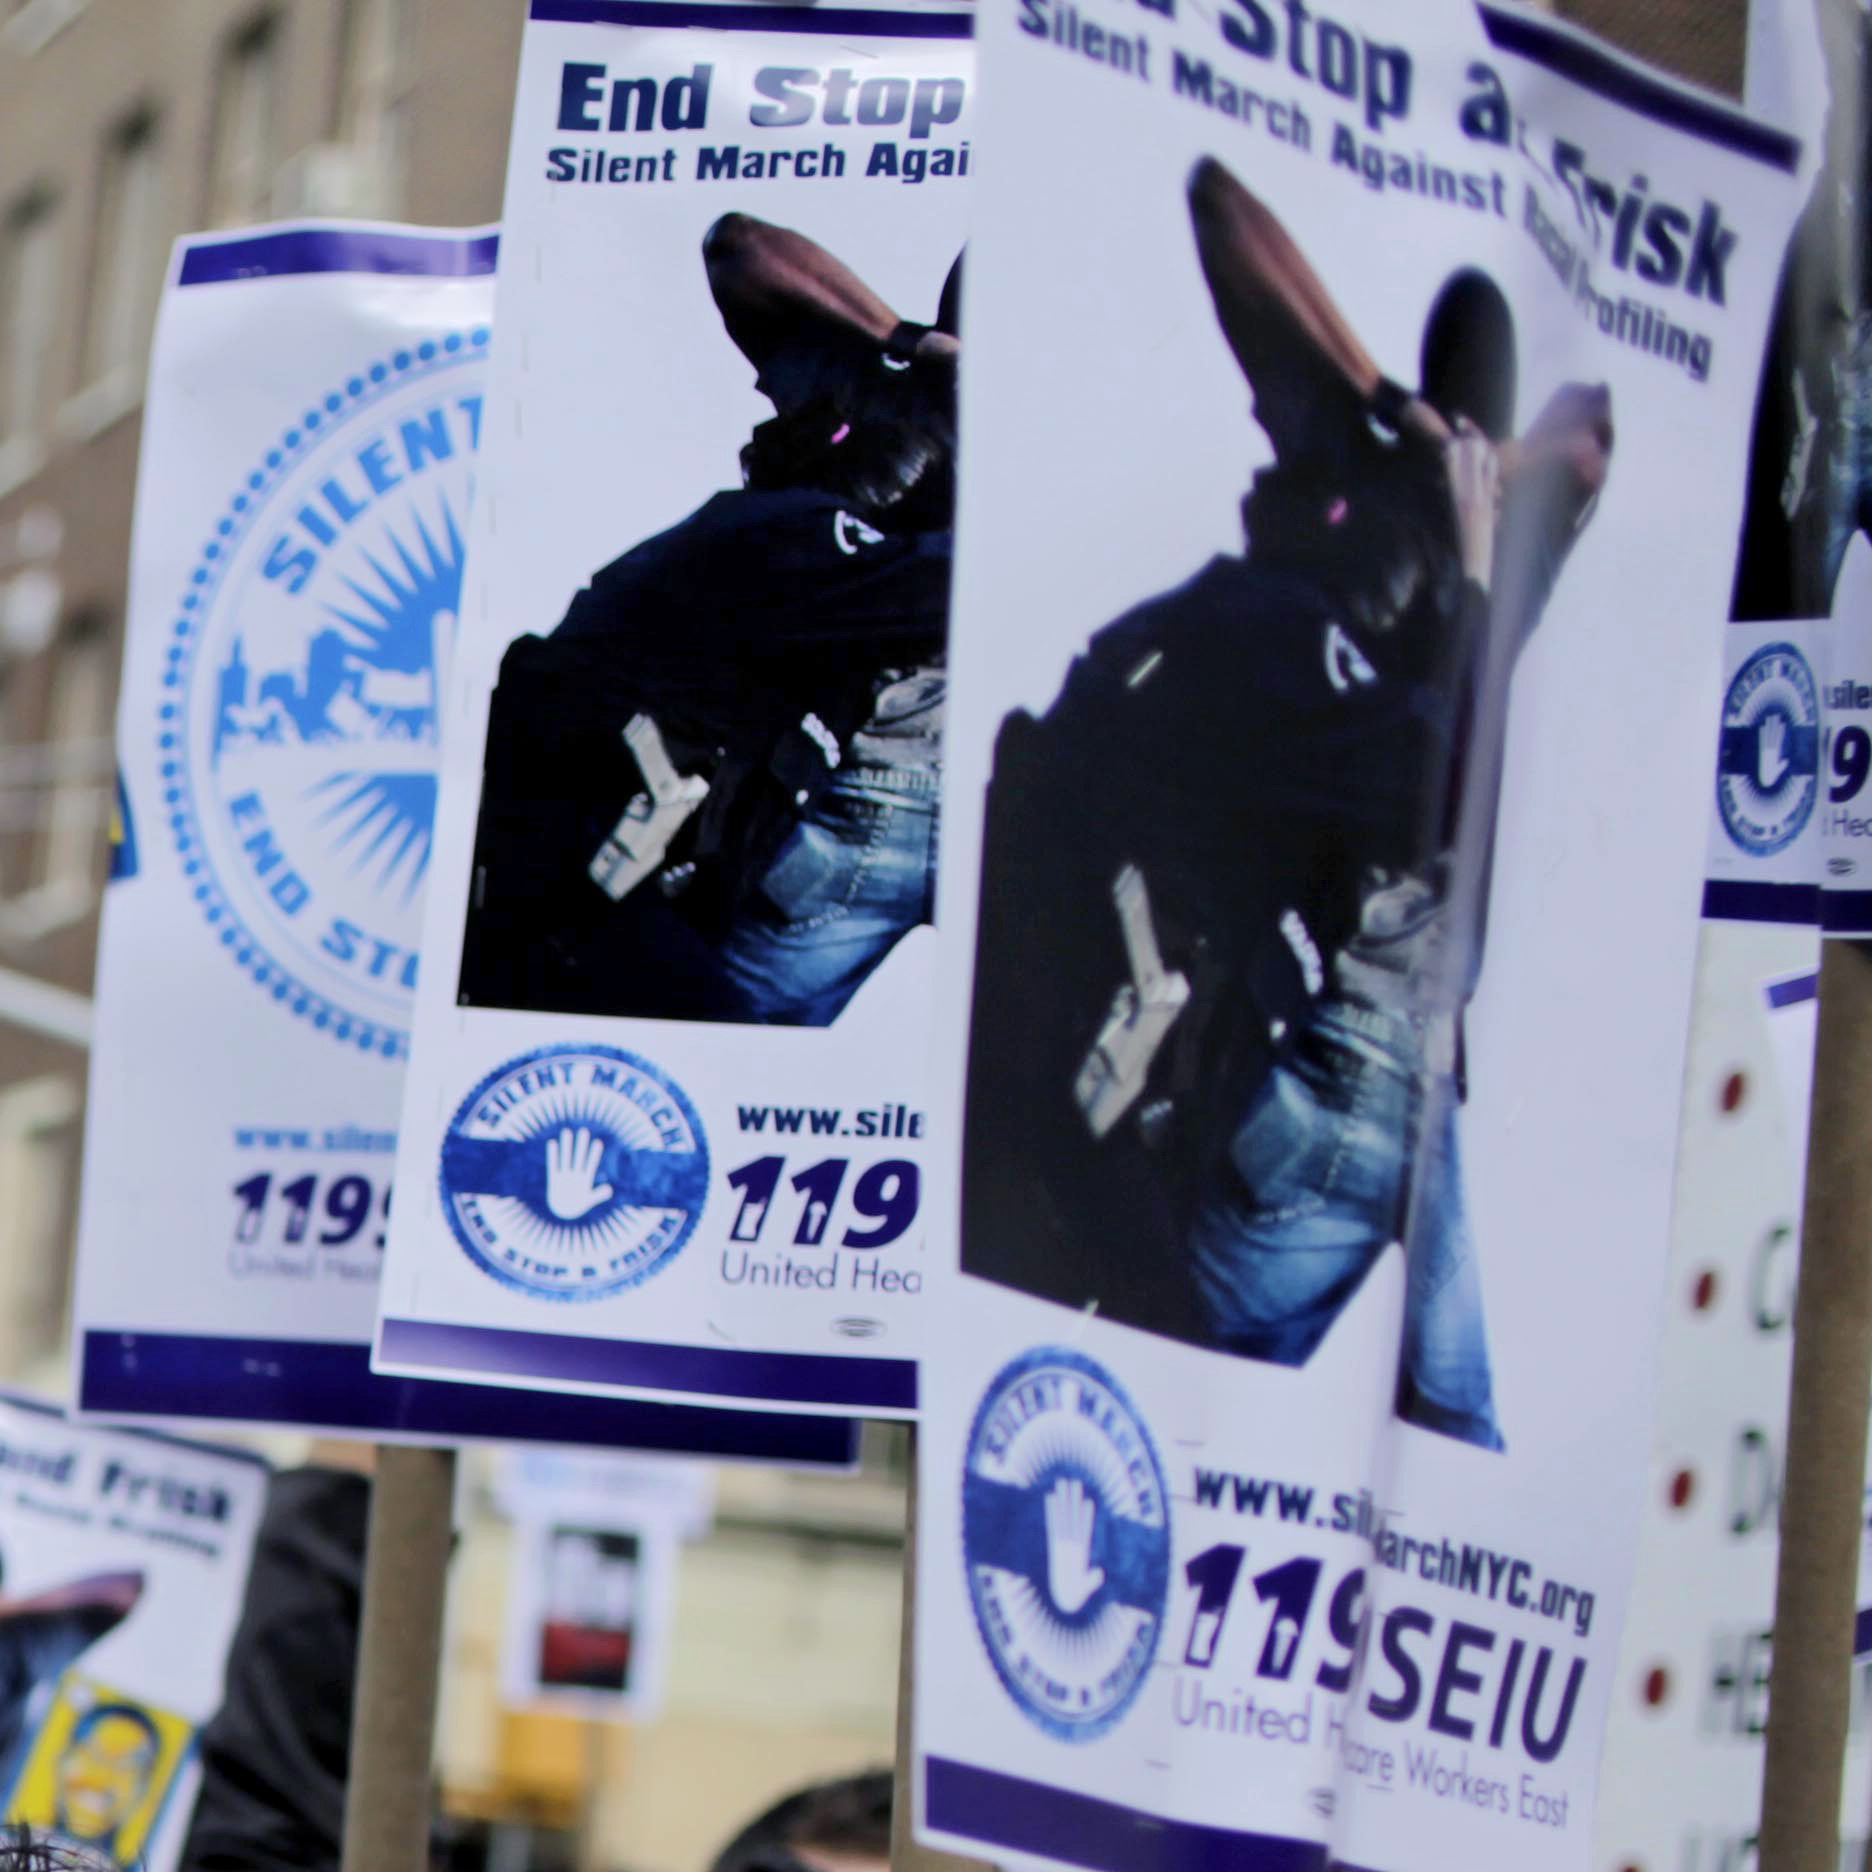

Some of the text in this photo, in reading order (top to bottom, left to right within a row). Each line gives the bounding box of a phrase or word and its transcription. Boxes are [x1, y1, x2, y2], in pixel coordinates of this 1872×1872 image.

[556, 62, 966, 139] End Stop
[1018, 0, 1151, 84] Silent
[1172, 48, 1311, 154] March
[1331, 120, 1506, 219] Against
[546, 141, 969, 183] Silent March Agai
[229, 787, 311, 916] END
[478, 1062, 683, 1147] SILENT MARCH
[738, 1103, 924, 1139] www.sile
[727, 1156, 921, 1250] 119
[720, 1250, 838, 1290] United
[1173, 1675, 1312, 1745] United
[1404, 1739, 1509, 1815] Workers
[1518, 1773, 1569, 1829] East
